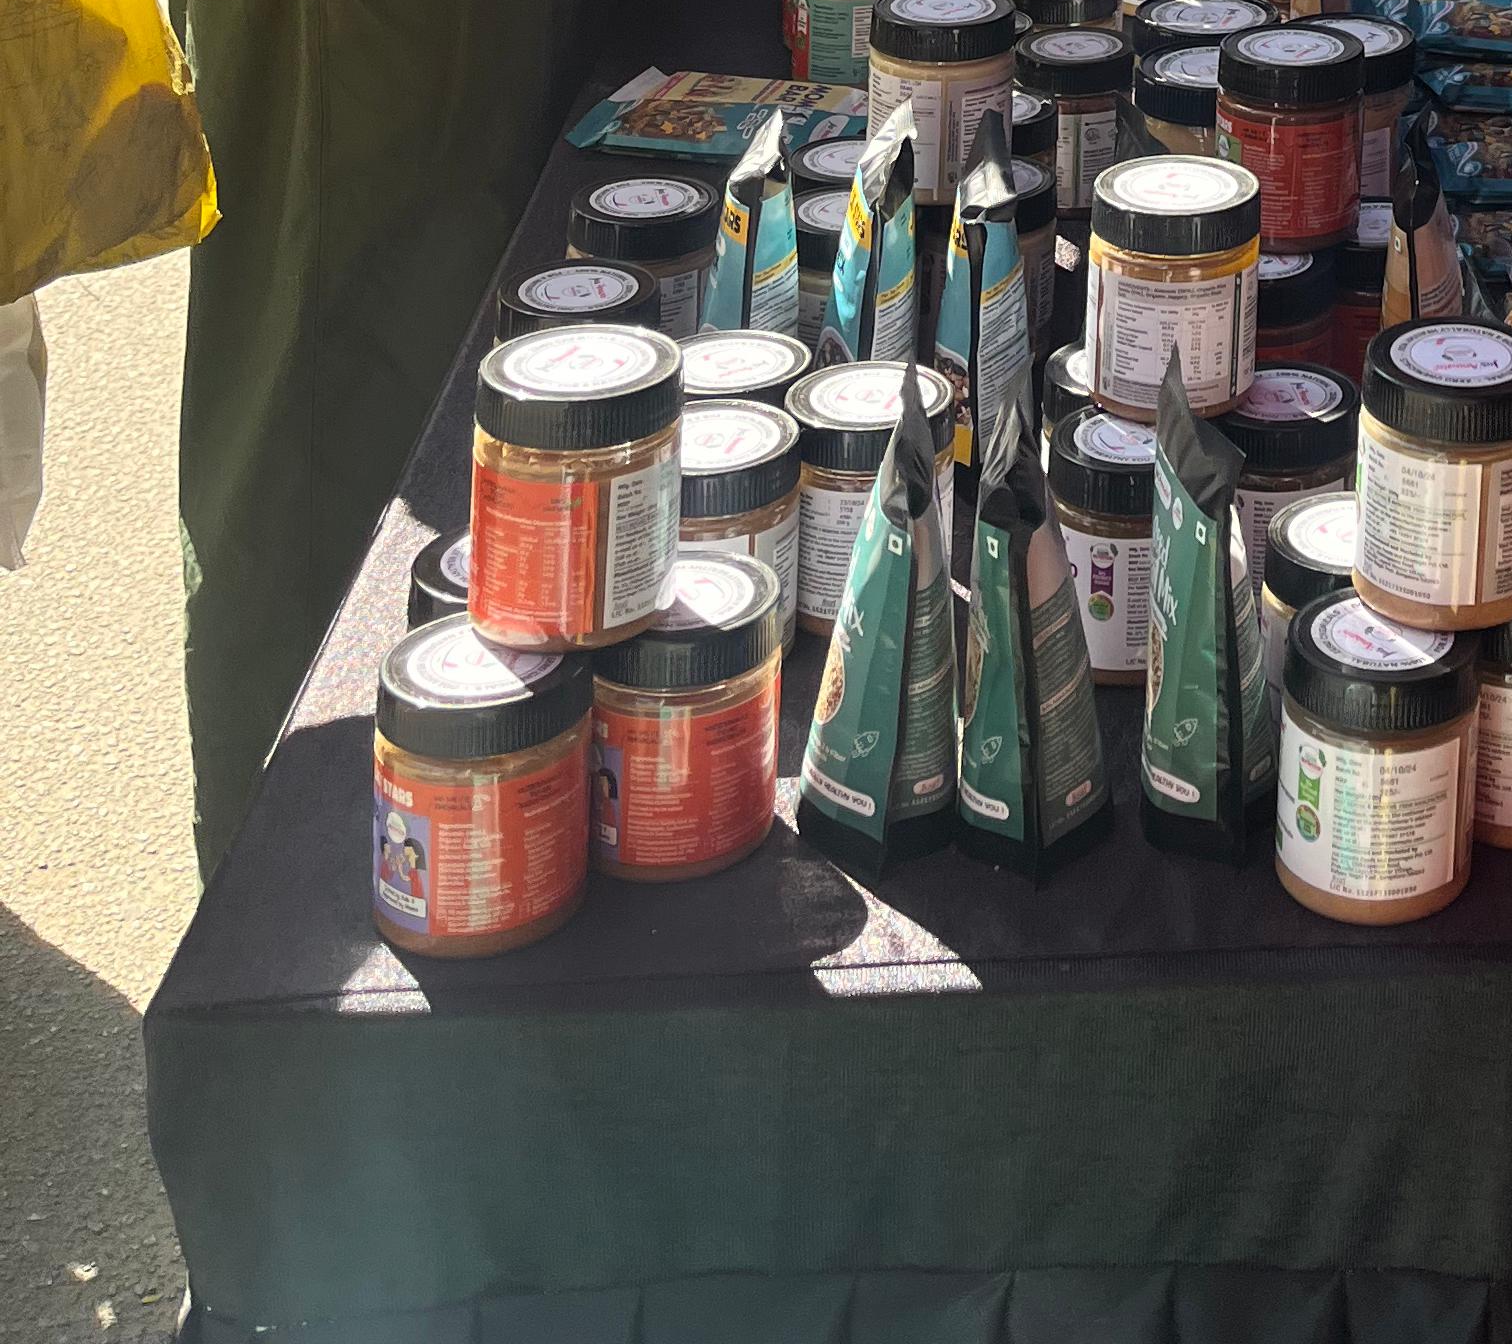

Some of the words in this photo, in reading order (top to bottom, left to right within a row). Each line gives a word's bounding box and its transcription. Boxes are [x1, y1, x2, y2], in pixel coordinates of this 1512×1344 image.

[775, 84, 809, 102] BAR
[1176, 782, 1190, 797] YOU
[851, 796, 867, 807] YOU
[985, 802, 1000, 814] YOU
